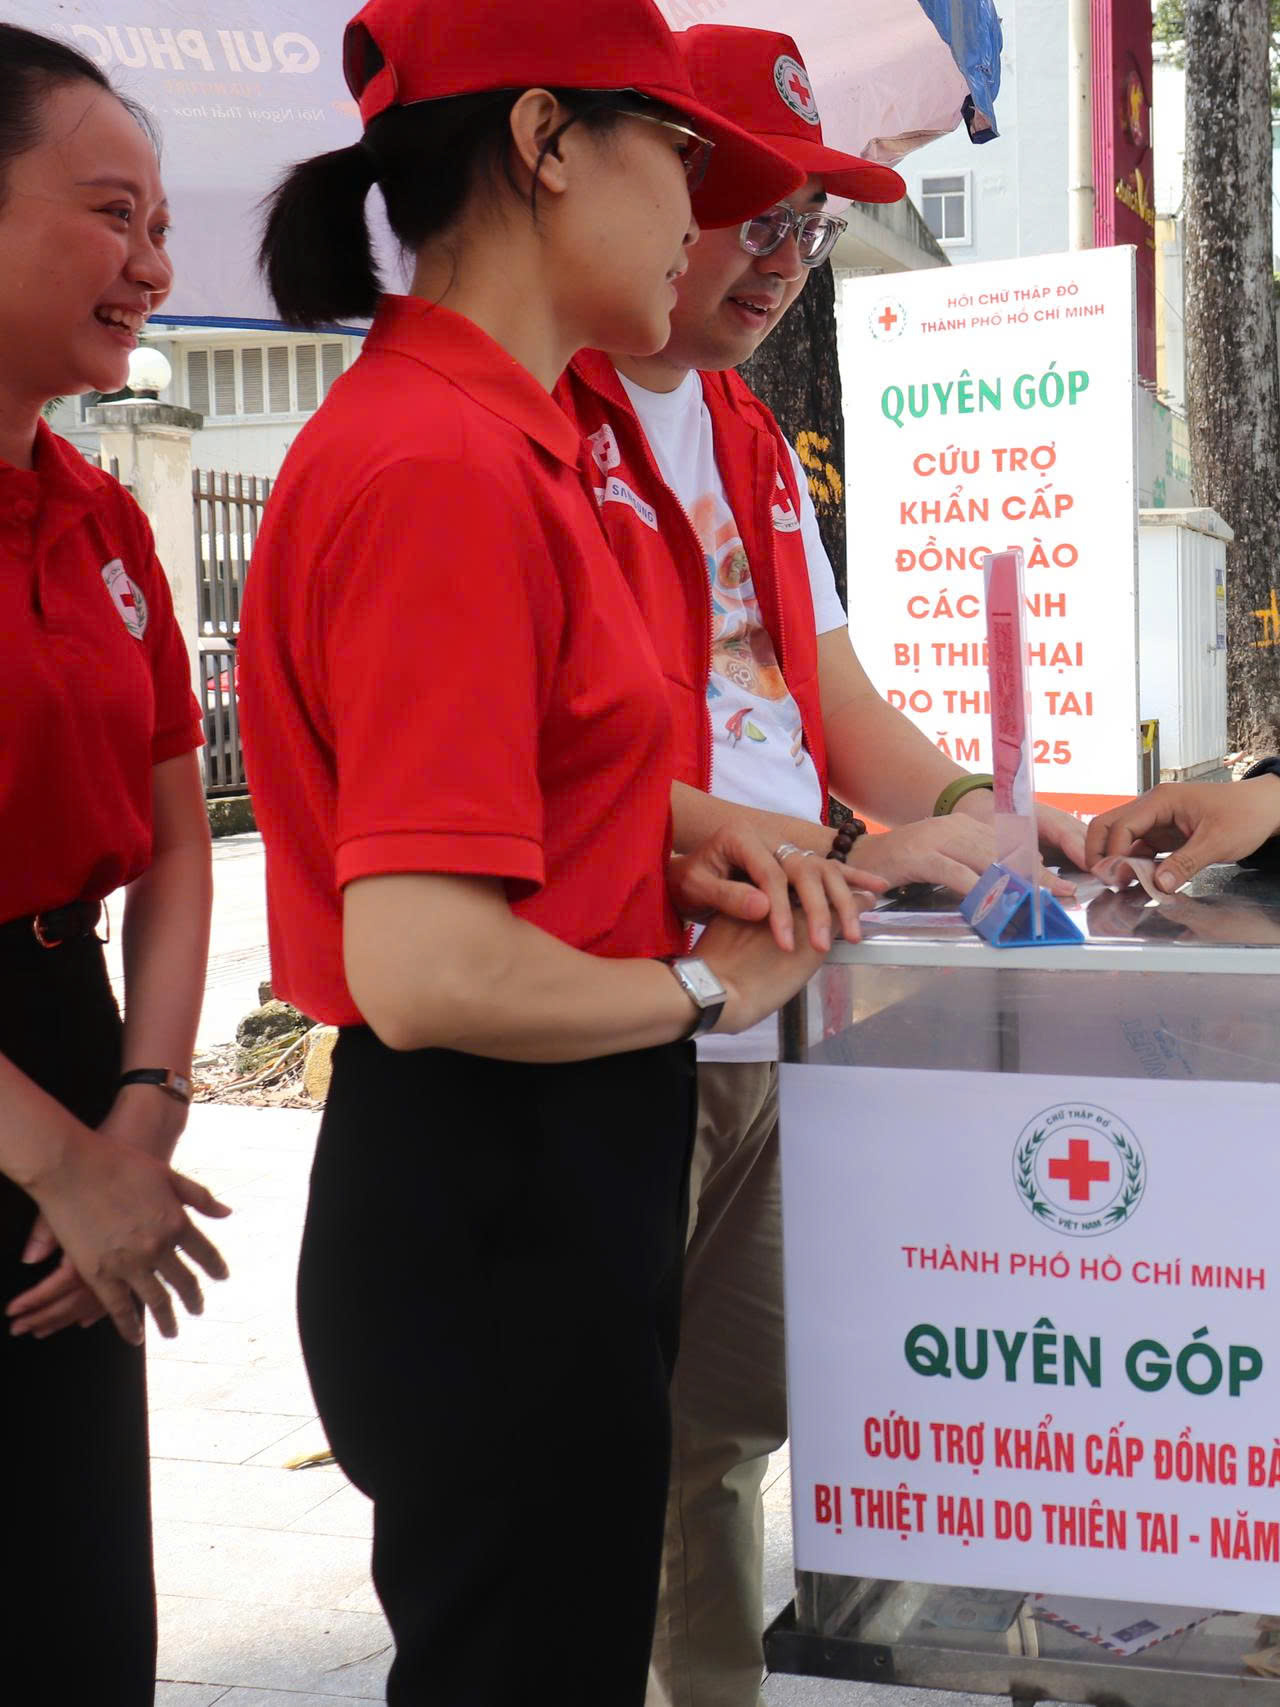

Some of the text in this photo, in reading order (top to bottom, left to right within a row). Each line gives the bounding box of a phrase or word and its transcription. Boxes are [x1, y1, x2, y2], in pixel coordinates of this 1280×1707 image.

[1065, 304, 1105, 318] MINH
[881, 360, 1090, 428] QUYÊN GÓP
[913, 441, 1057, 477] CỨU TRỢ
[900, 483, 1074, 525] KHẨN CẤP
[1007, 537, 1079, 569] ÀO
[907, 588, 980, 619] CÁC
[894, 643, 920, 673] BỊ
[1025, 642, 1083, 673] HẠI
[887, 689, 932, 714] DO
[1045, 691, 1093, 716] TAI
[935, 731, 1072, 765] ĂM 25
[901, 1244, 1000, 1275] THÀNH
[1132, 1258, 1181, 1286] CHÍ
[1191, 1264, 1266, 1291] MINH
[904, 1317, 1264, 1398] QUYÊN GÓP
[864, 1410, 921, 1461] CỨU
[929, 1422, 985, 1475] TRỢ
[994, 1413, 1075, 1473] KHẨN
[1085, 1421, 1144, 1477] CẤP
[1154, 1426, 1237, 1485] ĐỒNG
[814, 1484, 842, 1534] BỊ
[851, 1482, 927, 1540] THIỆT
[937, 1495, 984, 1546] HẠI
[994, 1500, 1032, 1542] DO
[1041, 1499, 1126, 1550] THIÊN
[1136, 1511, 1178, 1554] TAI
[1210, 1510, 1280, 1563] NĂM
